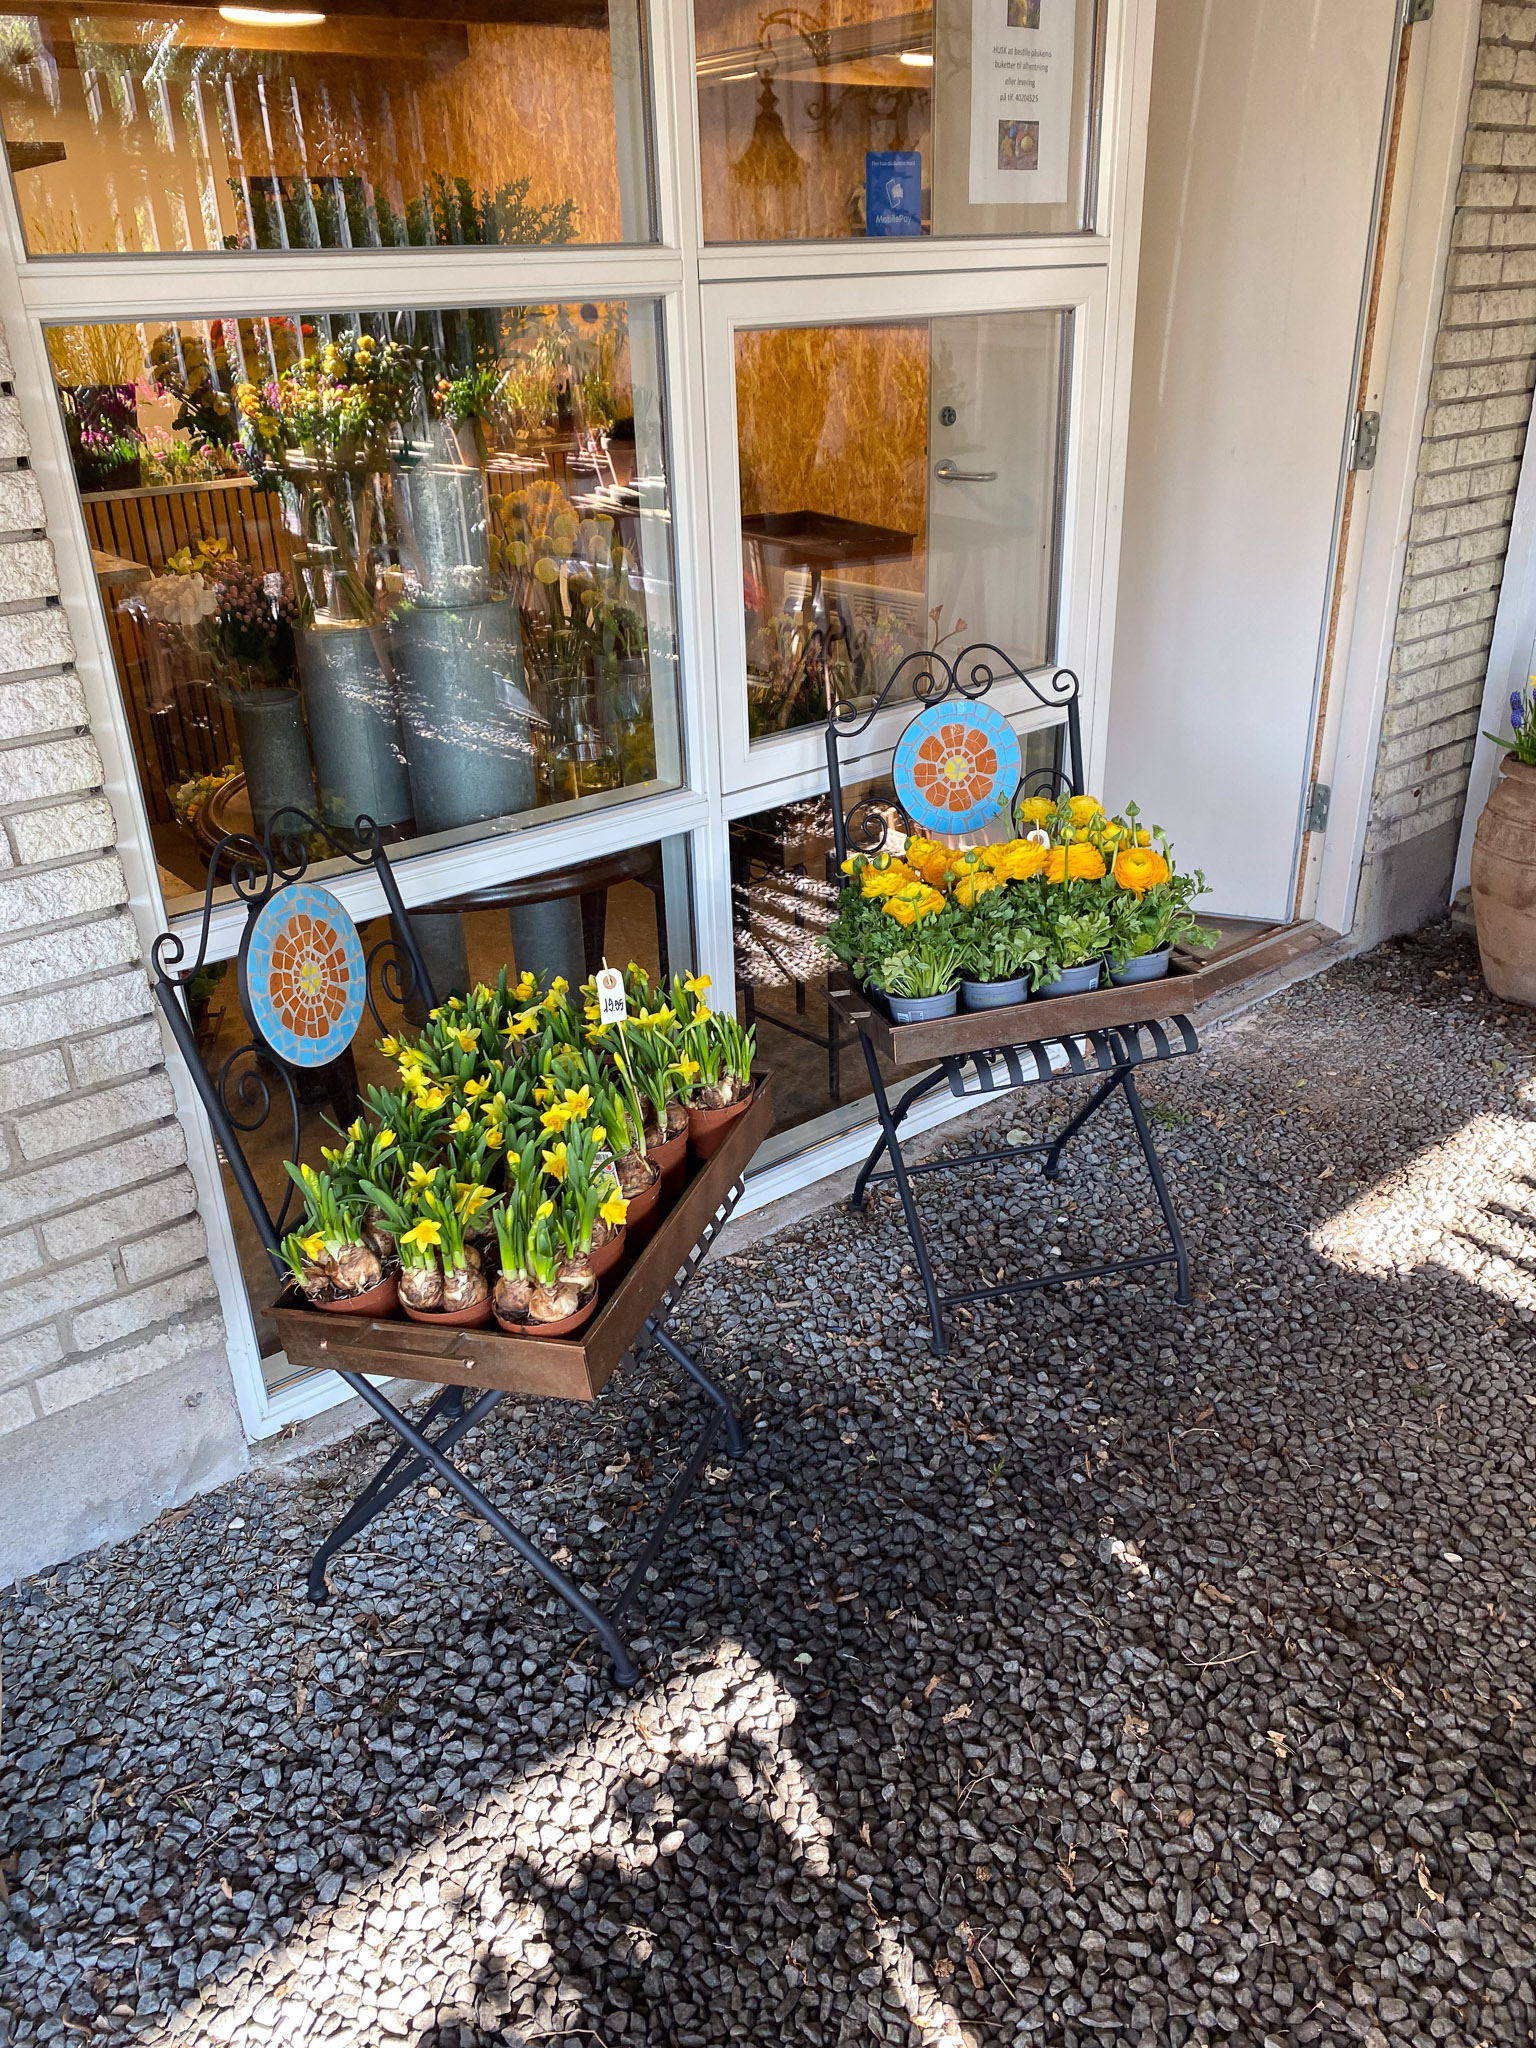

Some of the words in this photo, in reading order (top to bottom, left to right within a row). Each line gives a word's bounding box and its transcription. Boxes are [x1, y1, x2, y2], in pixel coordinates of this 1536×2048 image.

[993, 46, 1007, 54] HUSK
[995, 60, 1016, 69] buketter
[1005, 77, 1016, 86] eller
[1017, 77, 1035, 88] levering
[1000, 93, 1007, 102] på
[875, 215, 912, 224] MobilePay
